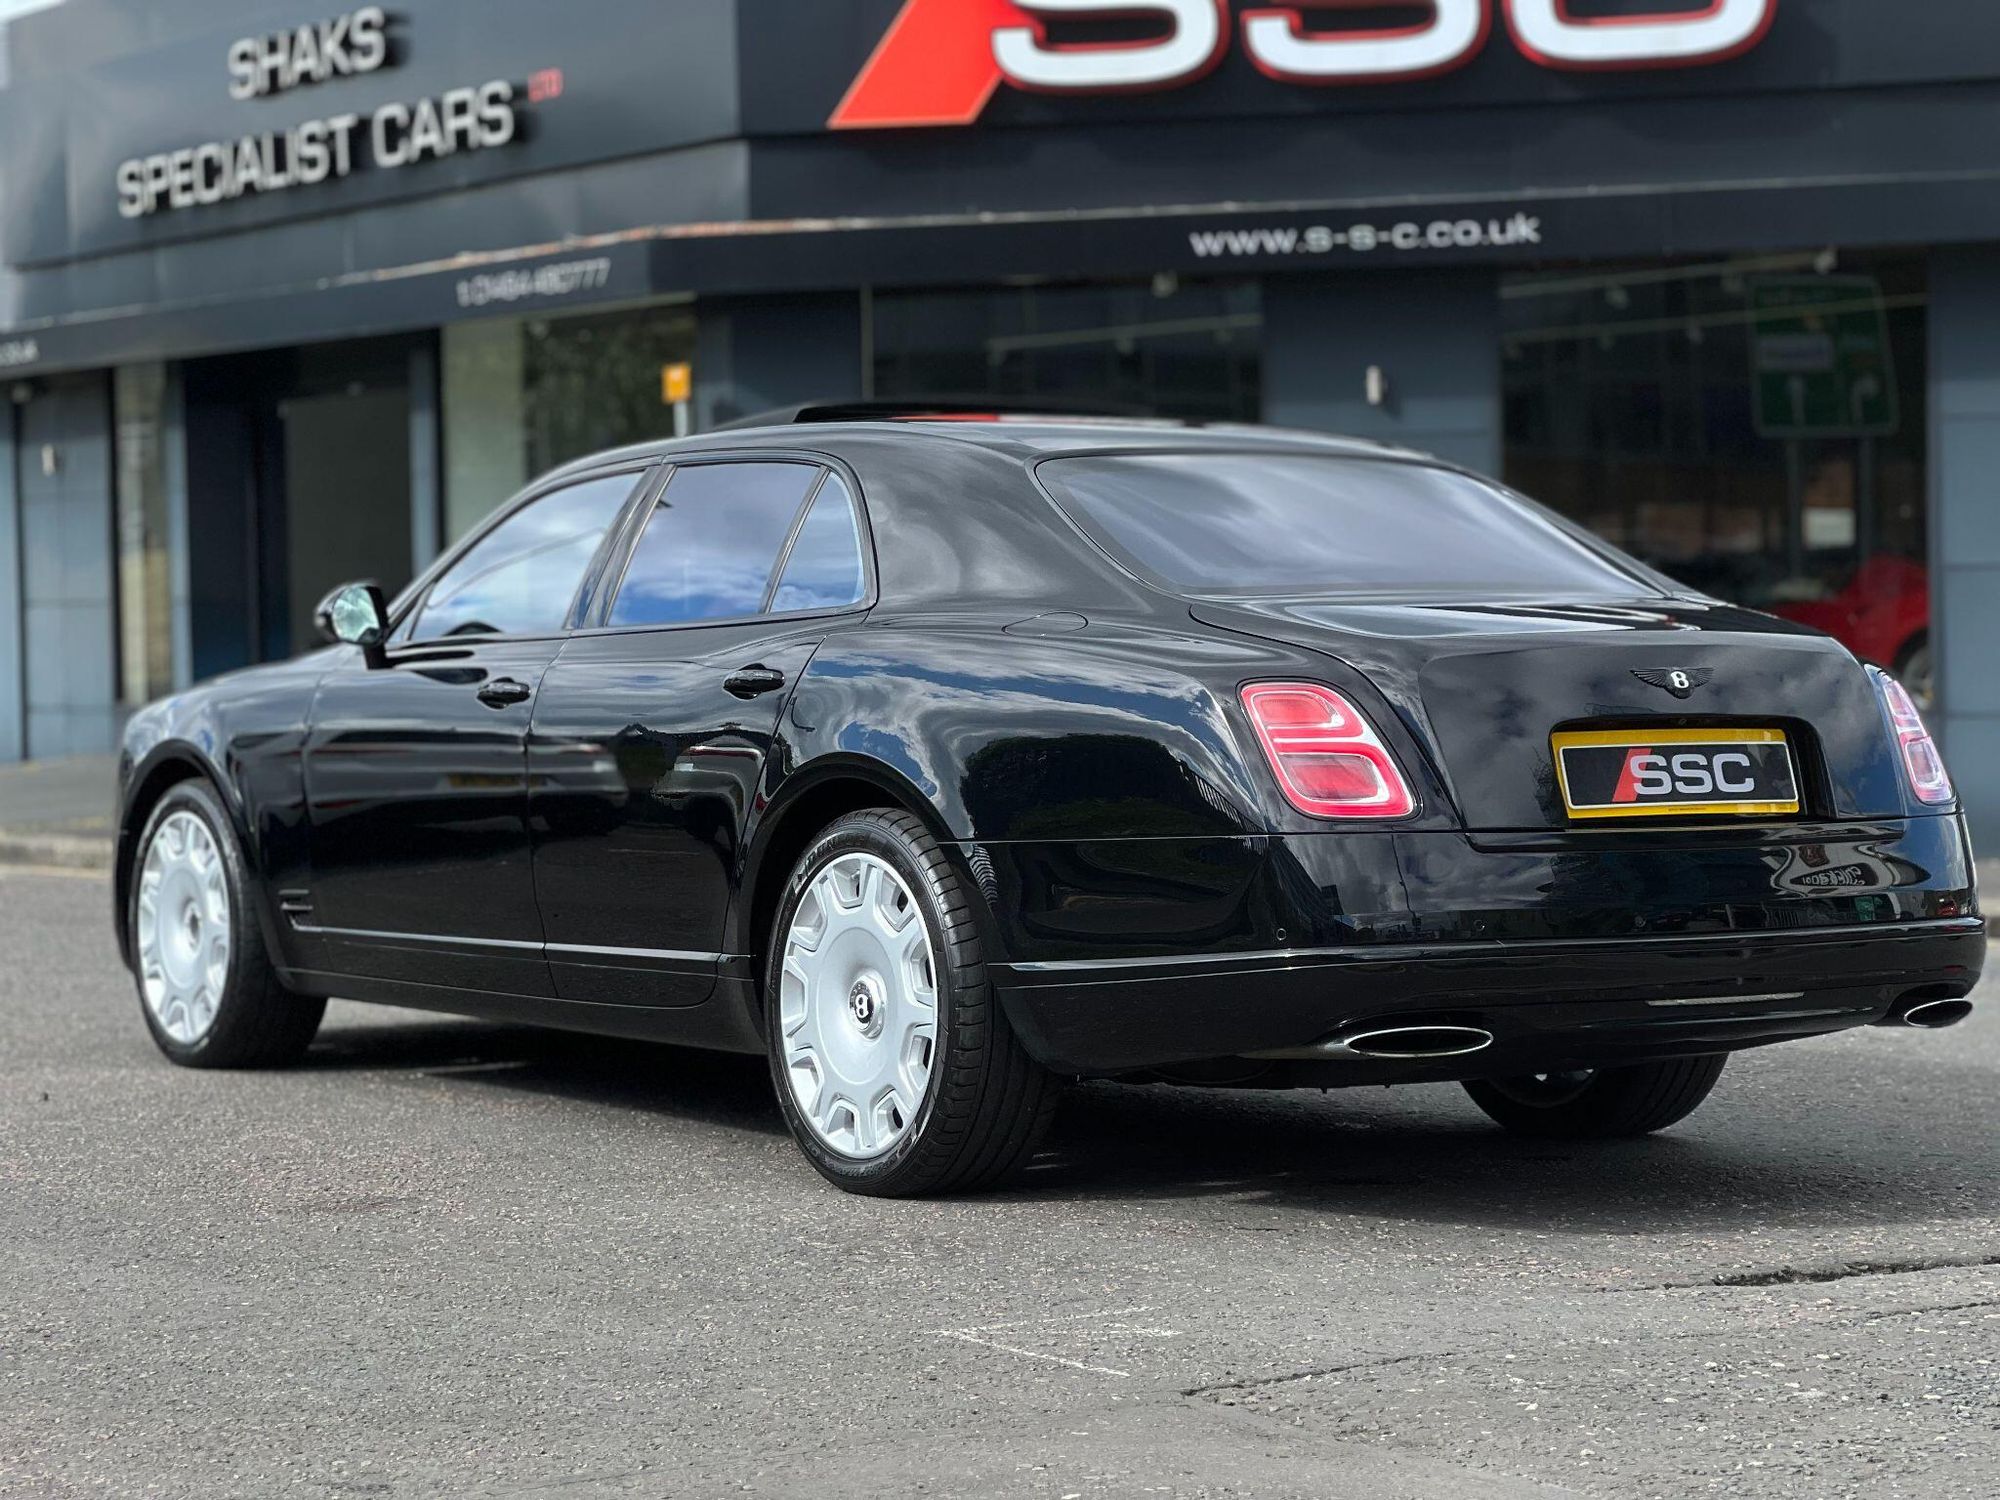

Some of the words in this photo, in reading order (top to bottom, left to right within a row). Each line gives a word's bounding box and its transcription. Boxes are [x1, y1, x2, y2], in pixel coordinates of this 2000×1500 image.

[228, 7, 386, 100] SHAKS
[117, 112, 357, 217] SPECIALIST
[372, 80, 515, 168] CARS
[1189, 214, 1543, 258] www.s-s-c.co.uk
[1630, 753, 1755, 795] SSC
